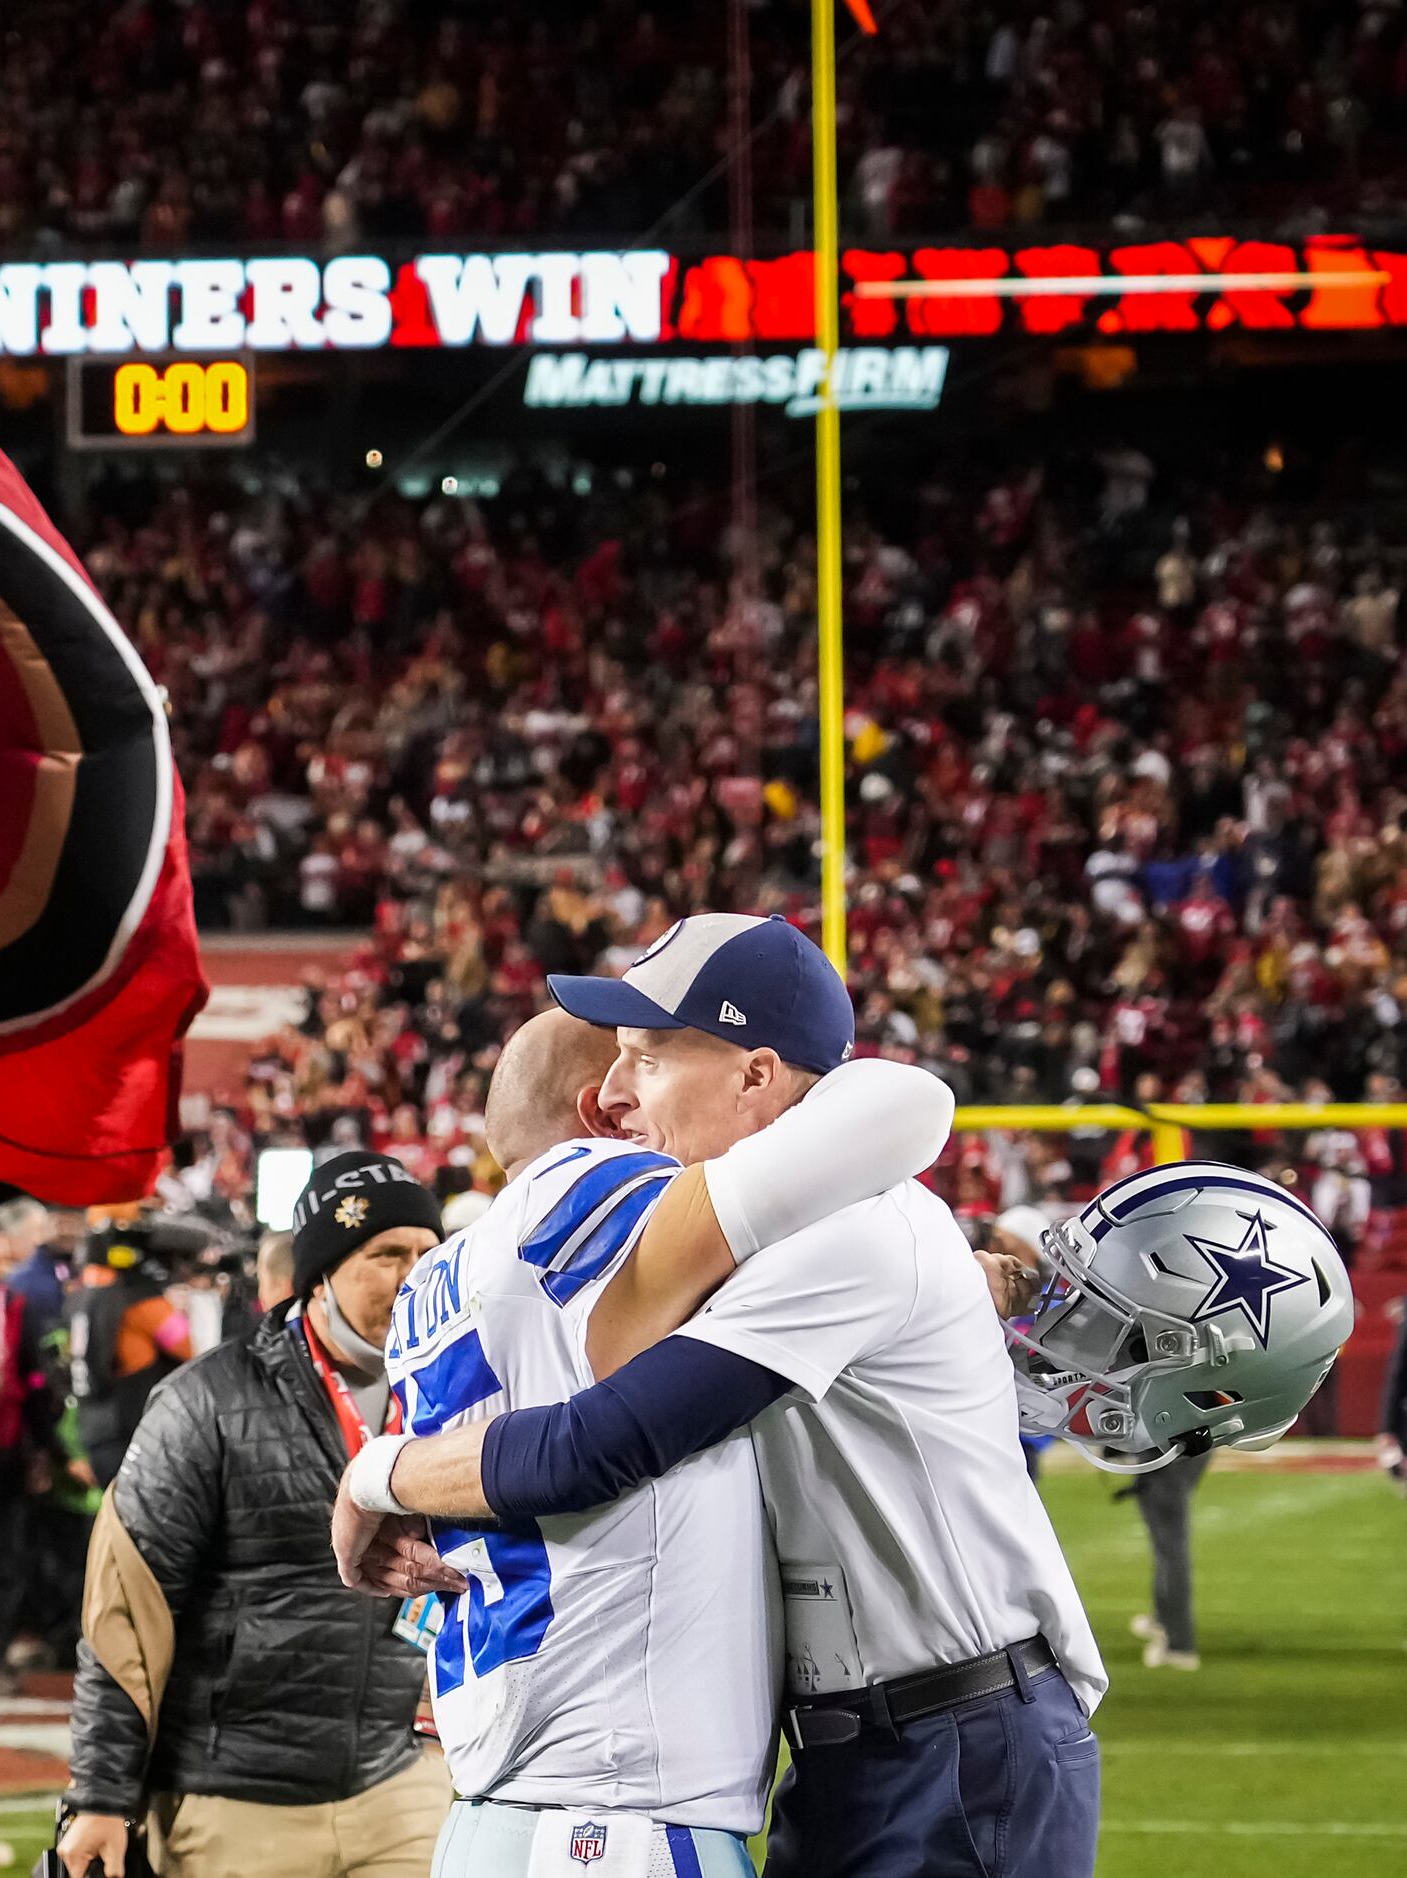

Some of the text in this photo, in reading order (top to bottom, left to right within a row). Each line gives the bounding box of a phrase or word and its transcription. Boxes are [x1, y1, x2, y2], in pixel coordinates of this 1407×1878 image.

[414, 250, 670, 344] WIN
[115, 361, 248, 434] 0:00
[573, 1839, 601, 1860] NFL
